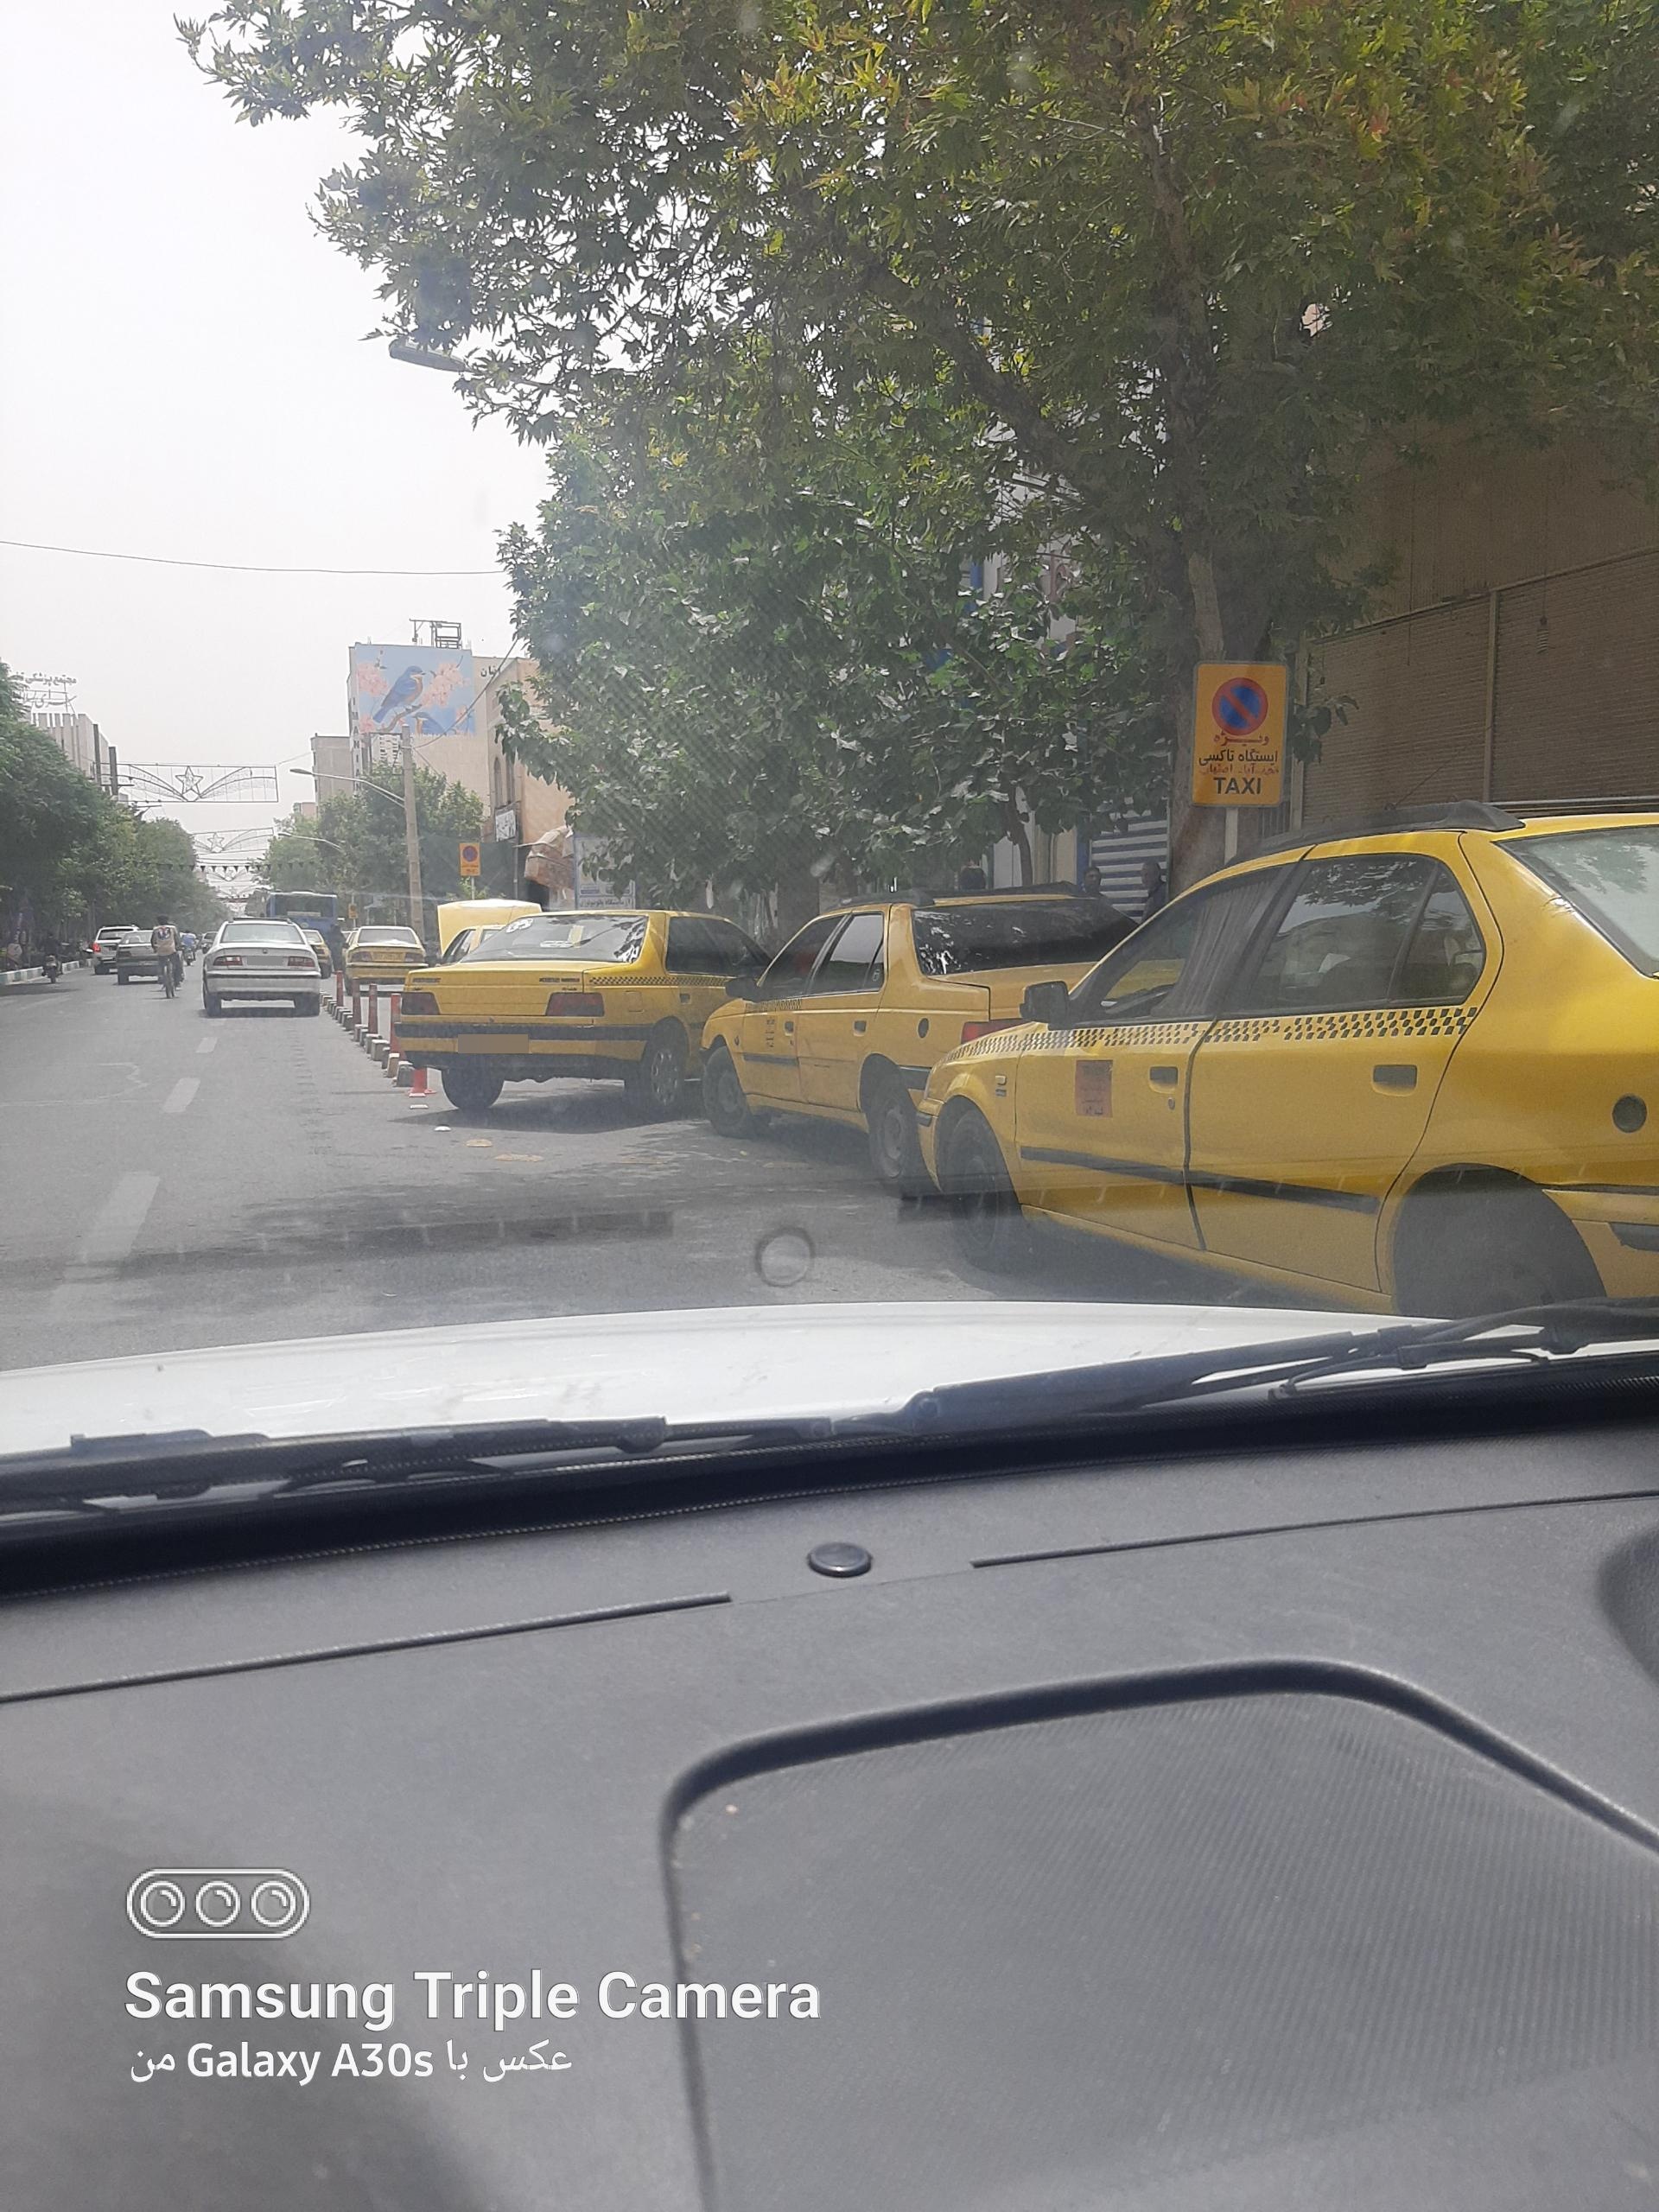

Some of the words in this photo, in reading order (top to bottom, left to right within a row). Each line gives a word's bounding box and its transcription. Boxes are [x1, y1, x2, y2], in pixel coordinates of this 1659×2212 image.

[1198, 748, 1234, 766] تاکسی
[1237, 748, 1278, 765] ایستگاه
[1213, 778, 1262, 794] TAXI
